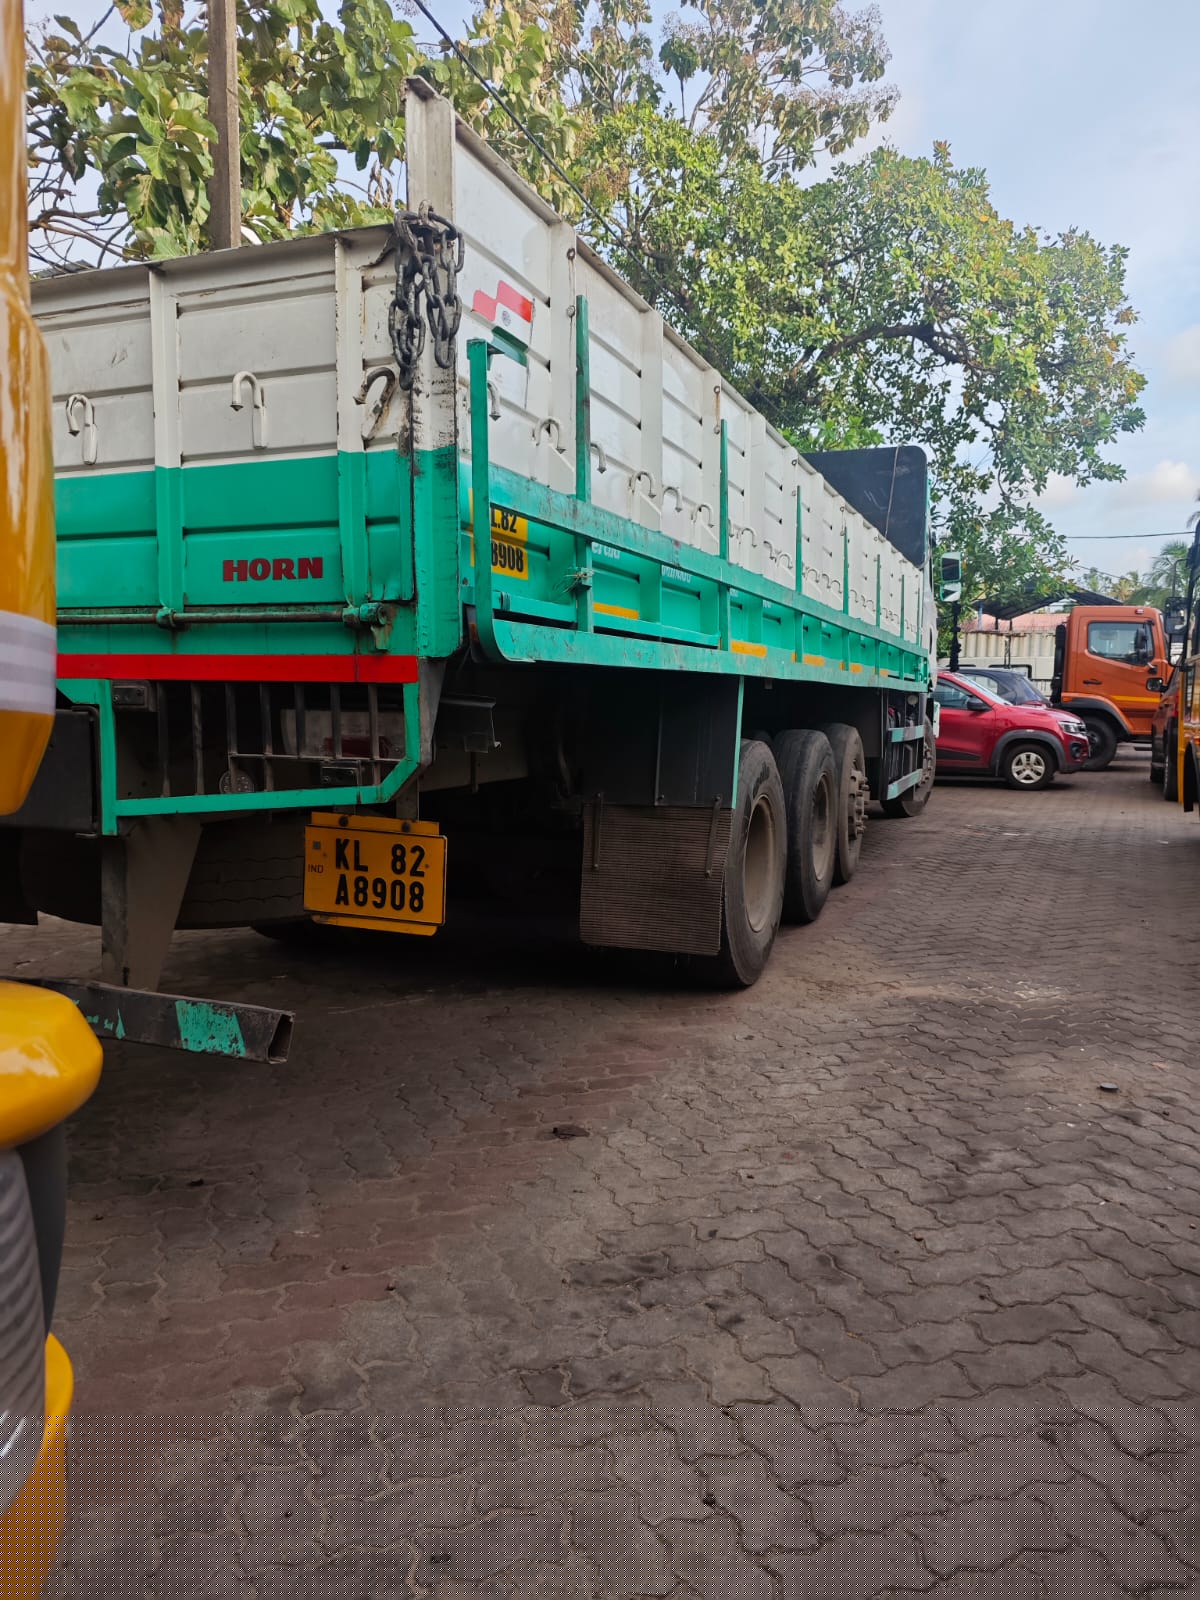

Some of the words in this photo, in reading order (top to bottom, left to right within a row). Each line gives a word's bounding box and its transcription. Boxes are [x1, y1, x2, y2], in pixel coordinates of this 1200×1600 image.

[491, 507, 517, 534] L.82
[223, 556, 324, 582] HORN
[491, 541, 524, 573] 8908
[307, 864, 324, 874] IND
[335, 838, 369, 872] KL
[391, 843, 425, 878] 82
[335, 873, 425, 913] A8908
